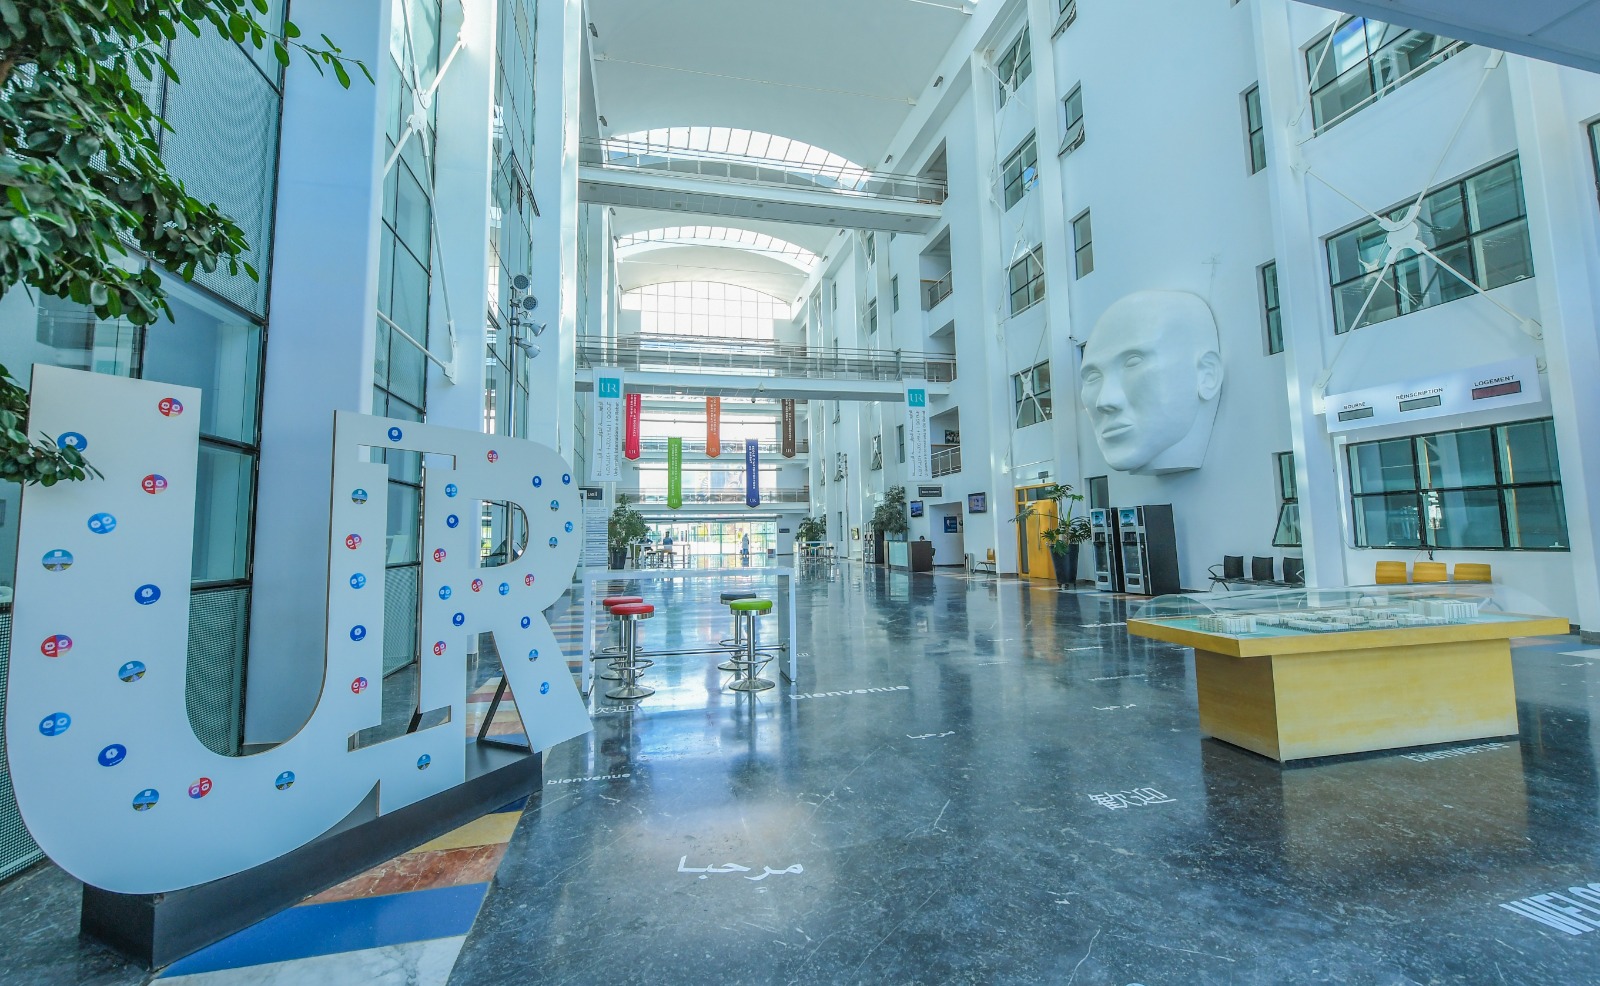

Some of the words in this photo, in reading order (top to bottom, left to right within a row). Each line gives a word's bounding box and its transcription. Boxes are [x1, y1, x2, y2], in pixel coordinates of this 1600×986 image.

[1474, 375, 1515, 387] LOGEMENT
[788, 685, 910, 700] bienvenue
[546, 773, 631, 785] bienvenue
[677, 854, 804, 881] مرحبا
